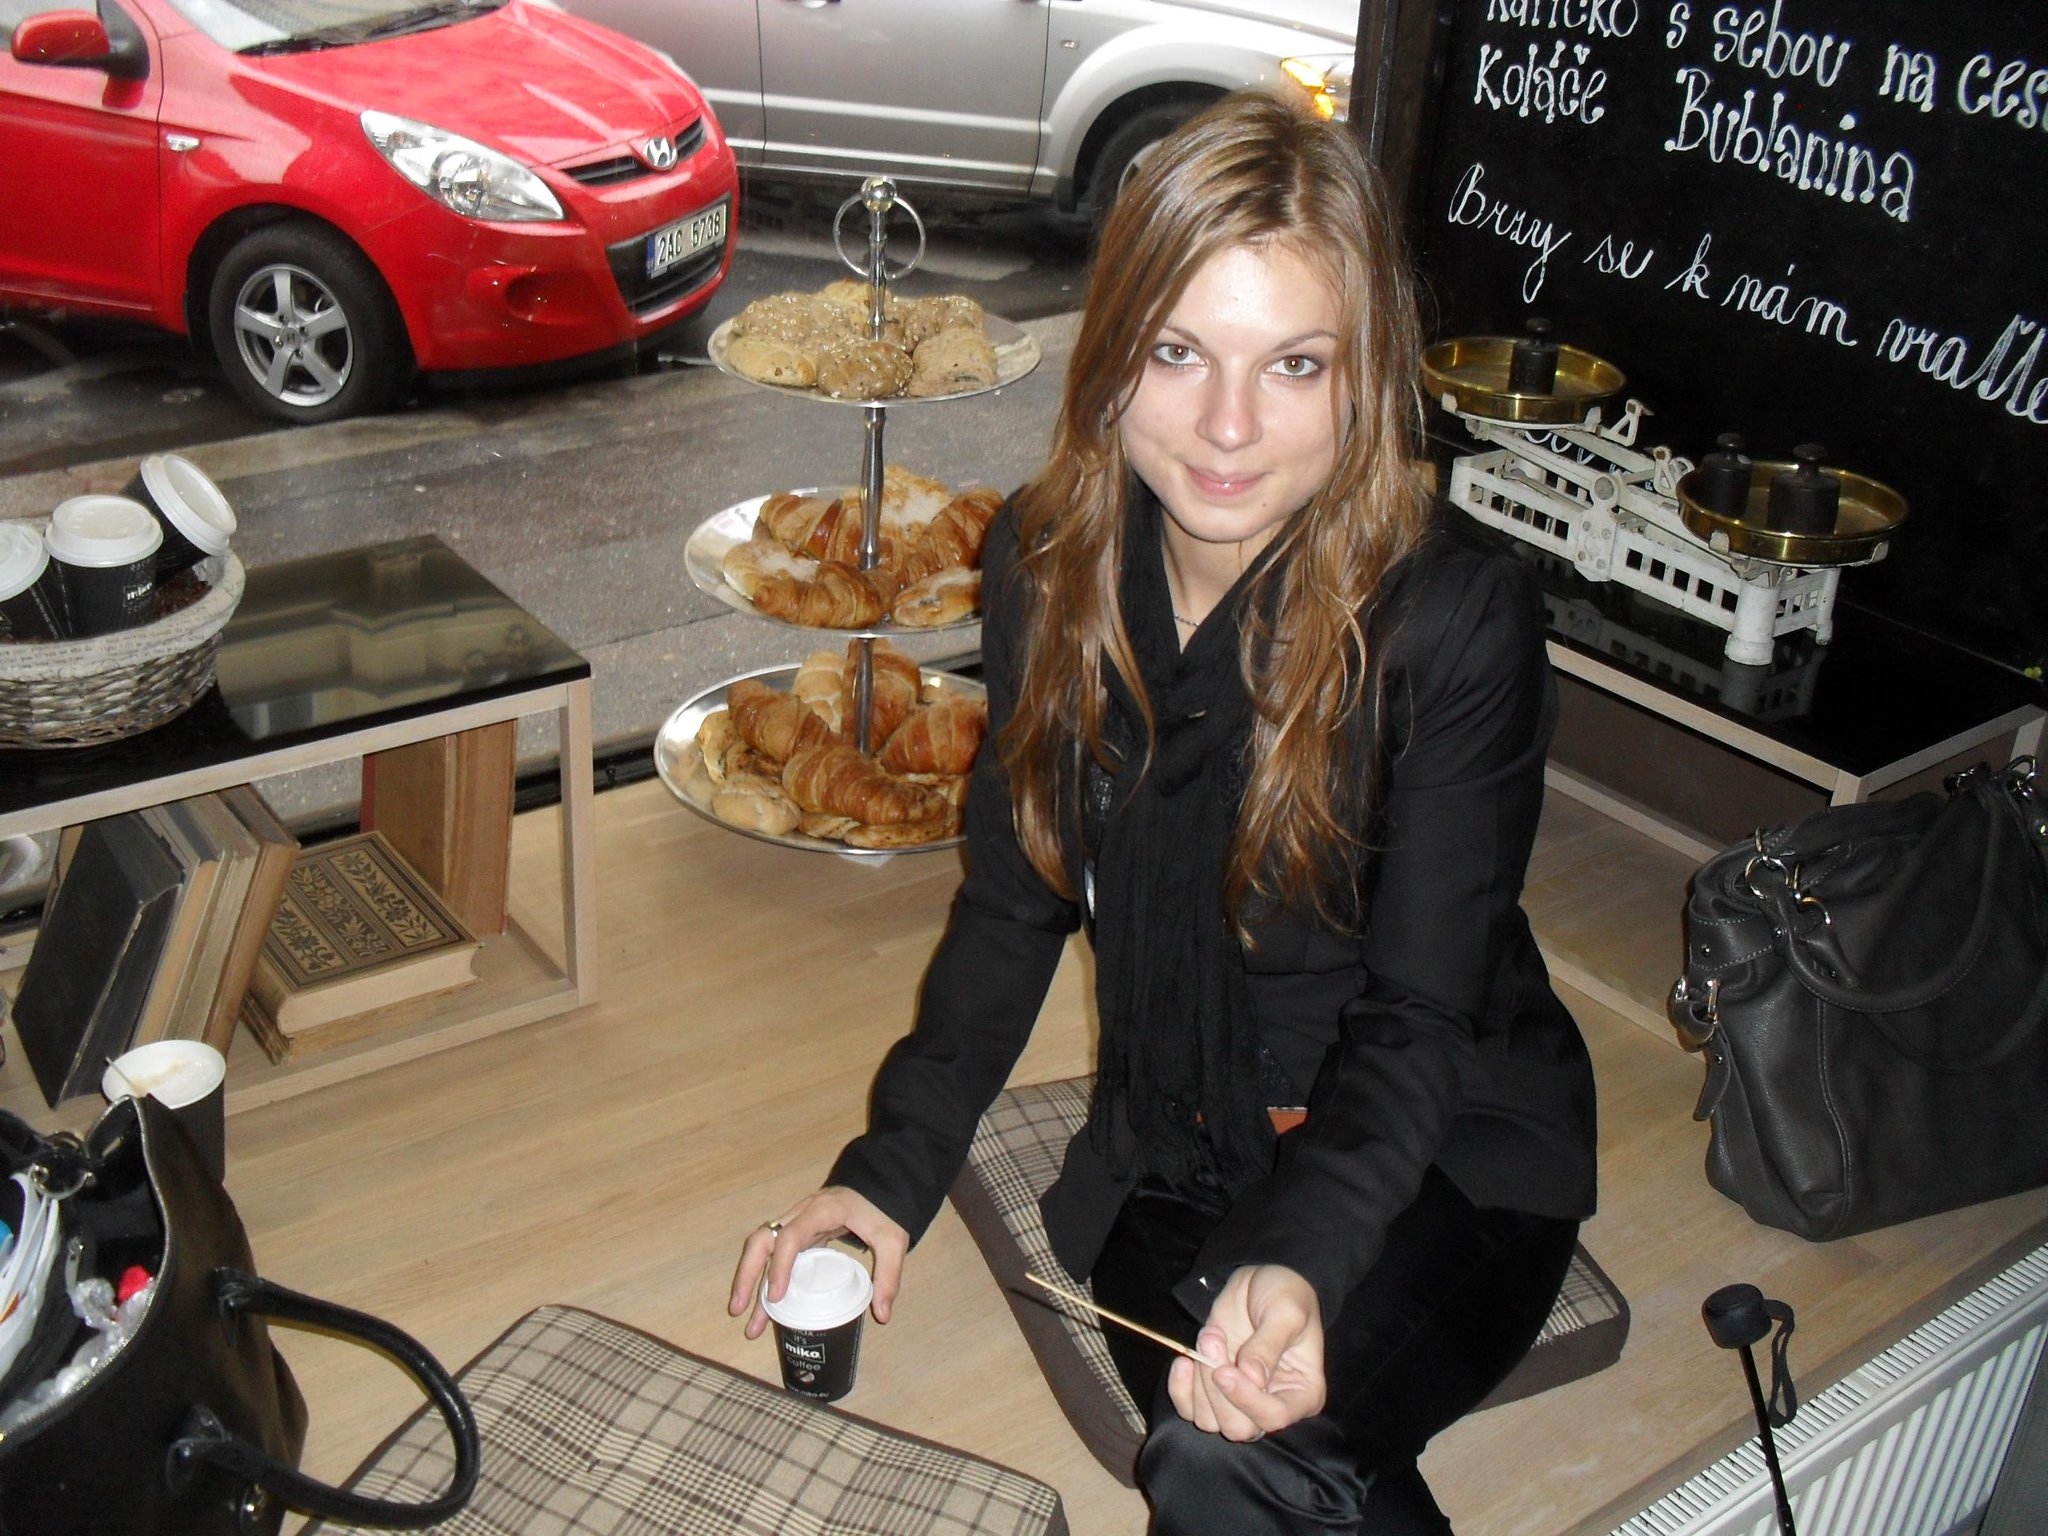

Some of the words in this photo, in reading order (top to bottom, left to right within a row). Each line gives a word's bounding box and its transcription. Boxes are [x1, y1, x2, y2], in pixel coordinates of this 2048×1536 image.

[1474, 40, 1608, 124] Koláče
[1664, 68, 1910, 222] Bublanina
[1666, 2, 1691, 49] s
[1713, 0, 1850, 87] sebou
[1879, 44, 1936, 113] na
[1957, 53, 2048, 133] ces
[657, 230, 683, 265] 2AC
[1448, 162, 1573, 304] Brzy
[1582, 233, 1655, 279] se
[1663, 233, 1711, 299] k
[1719, 263, 1858, 346] nám
